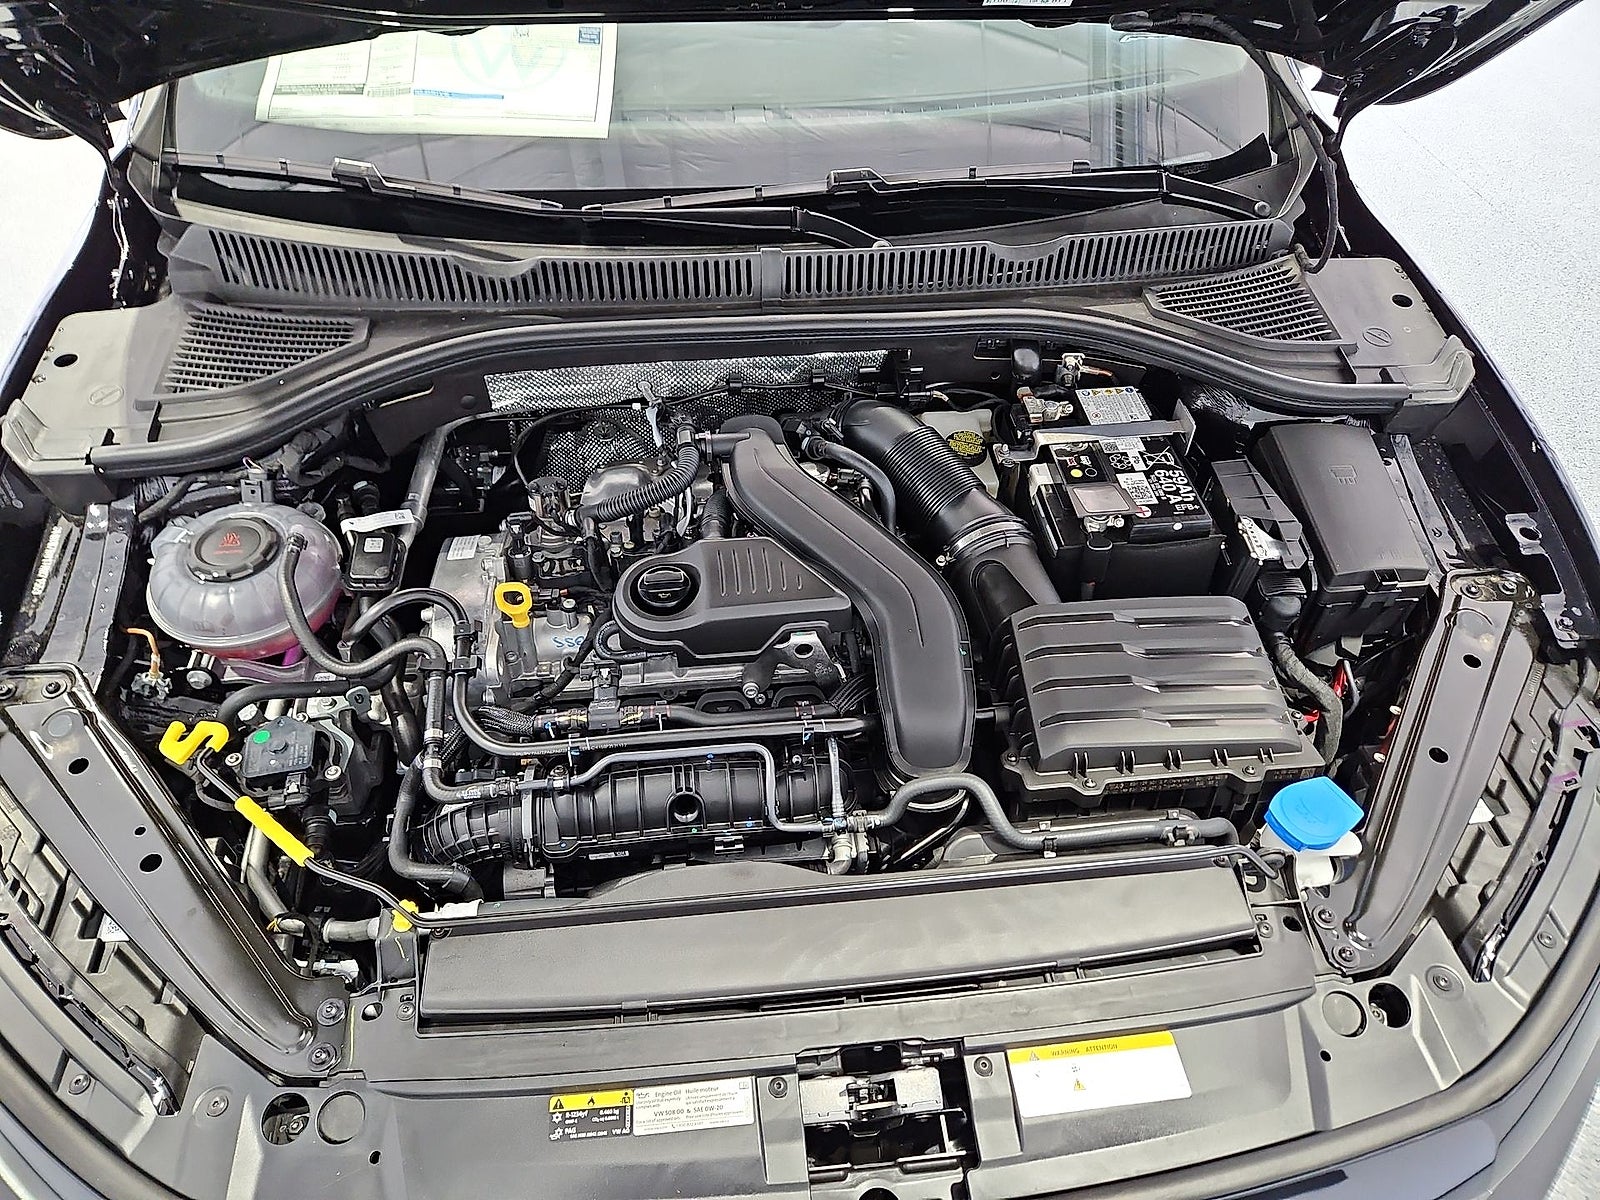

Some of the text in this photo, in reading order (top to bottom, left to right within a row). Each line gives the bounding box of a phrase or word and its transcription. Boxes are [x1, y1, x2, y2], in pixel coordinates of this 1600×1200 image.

[1154, 470, 1177, 492] 640
[1169, 470, 1196, 501] 59Ah
[1165, 494, 1183, 504] A
[1174, 503, 1200, 511] EFB+
[1086, 1044, 1118, 1052] ATTENTION
[655, 1090, 673, 1098] Engine
